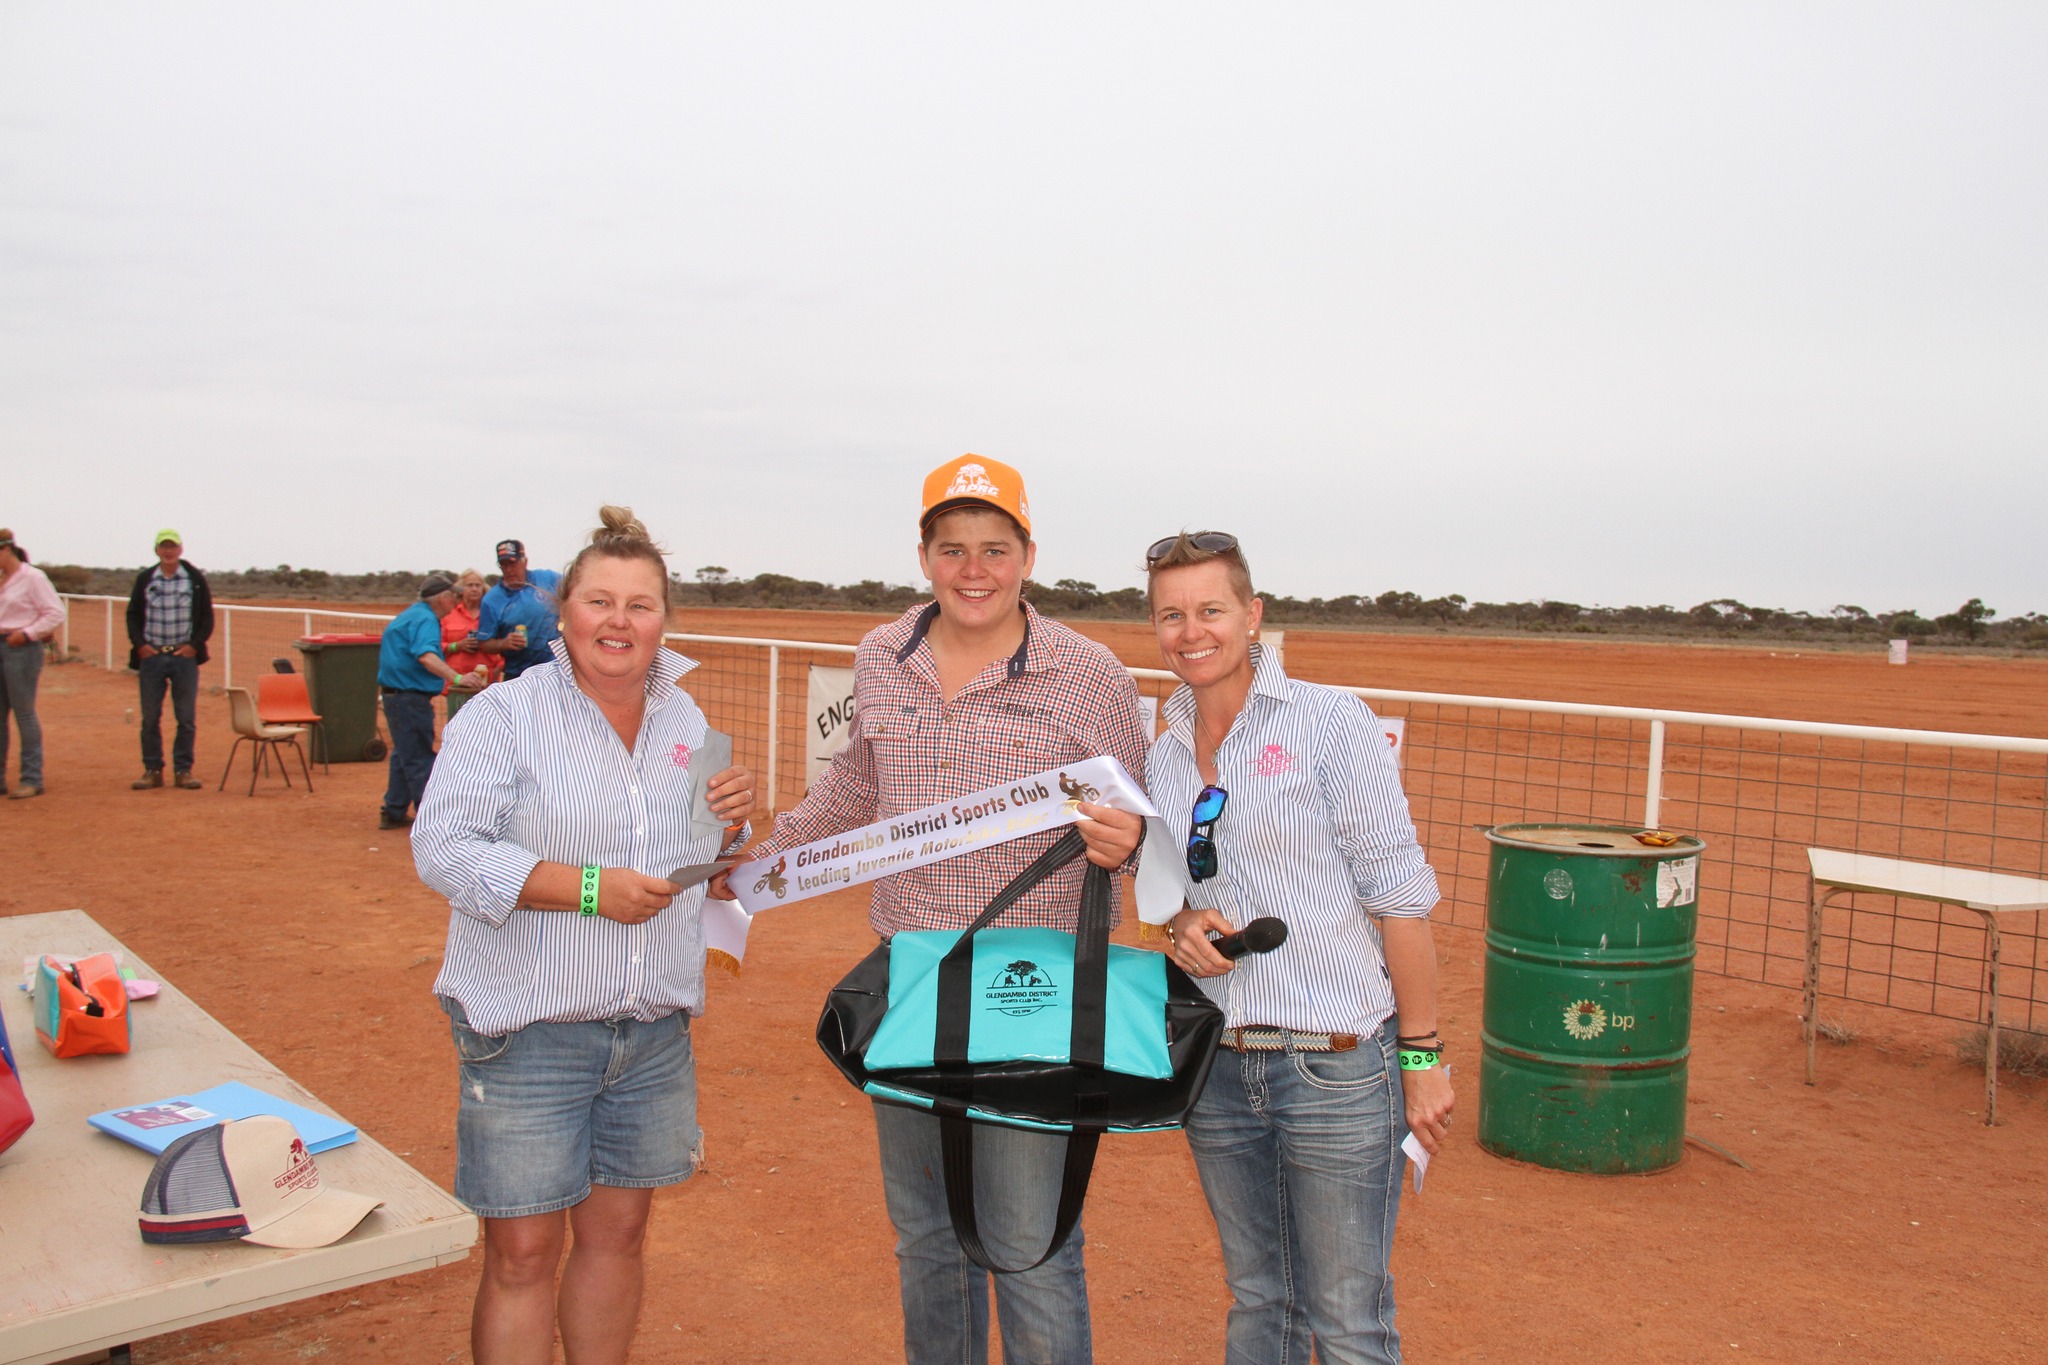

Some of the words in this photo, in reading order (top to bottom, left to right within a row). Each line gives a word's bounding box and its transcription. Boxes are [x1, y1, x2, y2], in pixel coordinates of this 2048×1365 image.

[817, 695, 854, 740] ENG
[796, 831, 885, 868] Glendambo
[889, 812, 947, 842] District
[952, 797, 1007, 826] Sports
[1010, 781, 1050, 807] Club
[797, 865, 851, 892] Leading
[986, 991, 1027, 999] GLENDAMBO
[1029, 990, 1058, 998] DISTRICT
[1612, 1011, 1635, 1031] bp
